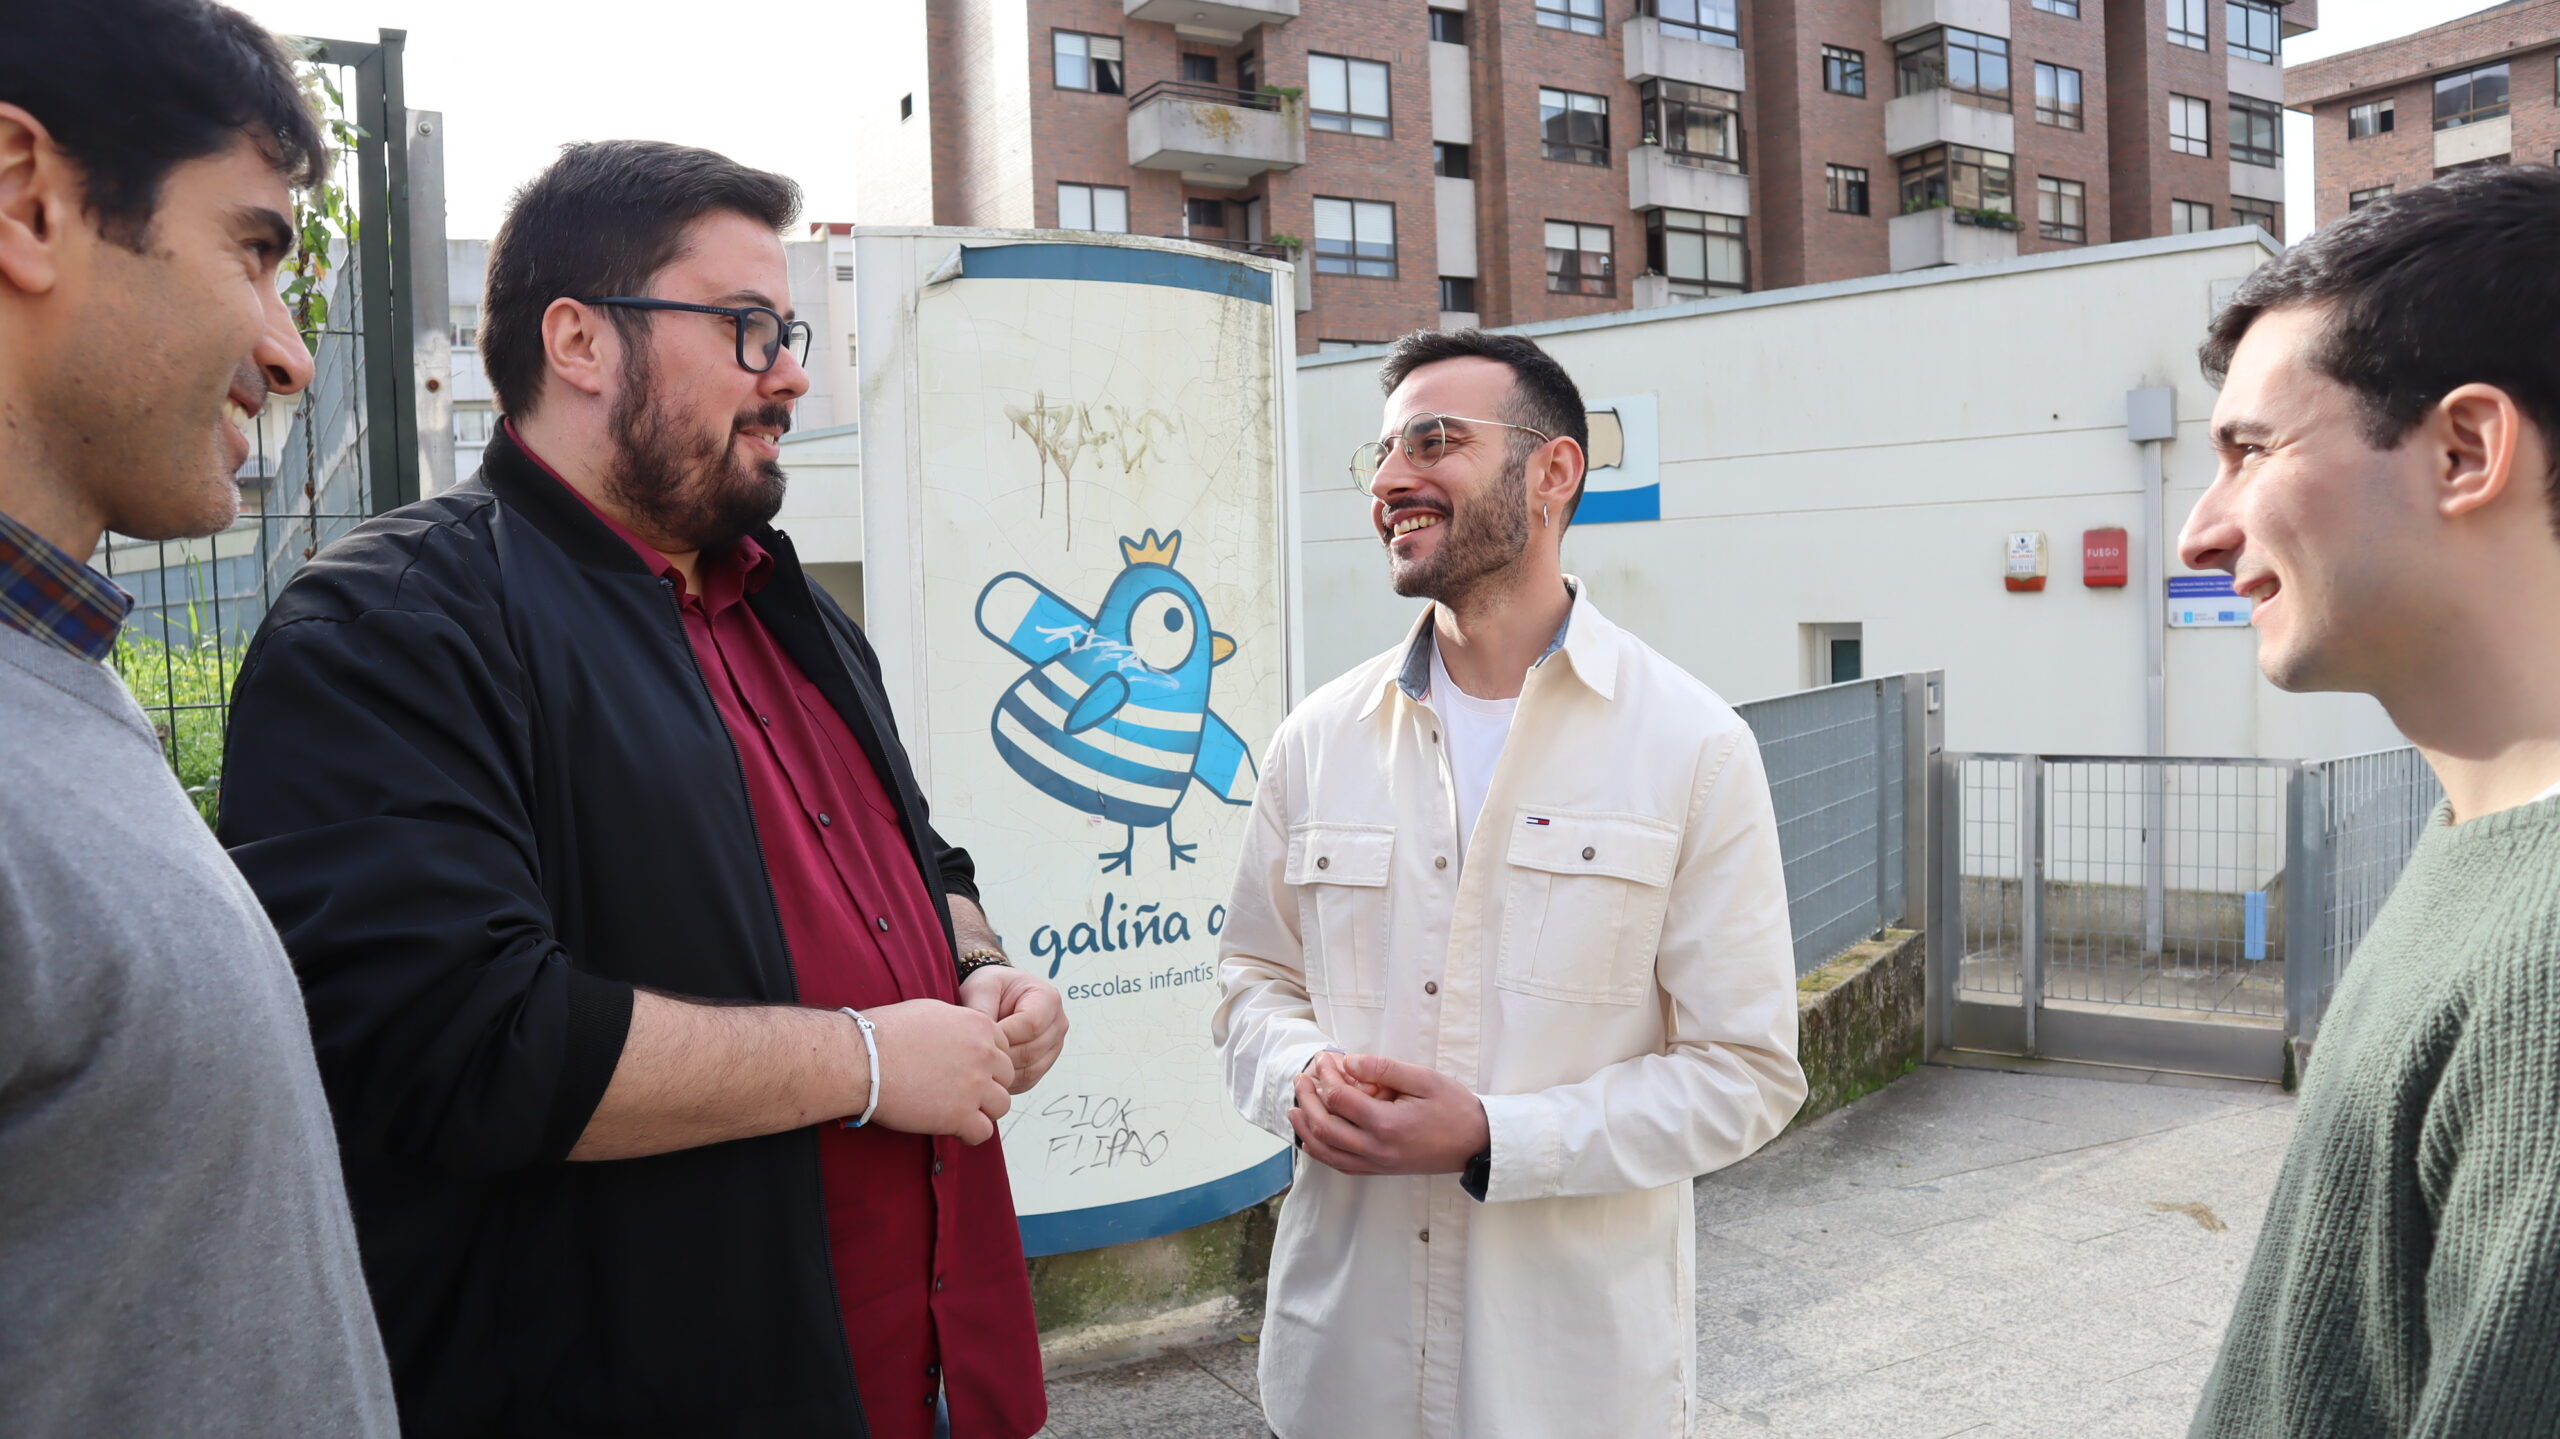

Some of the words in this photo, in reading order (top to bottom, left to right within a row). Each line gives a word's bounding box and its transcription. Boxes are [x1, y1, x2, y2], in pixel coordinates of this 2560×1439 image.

[2087, 547, 2119, 558] FUEGO
[1029, 891, 1191, 979] galiña
[1067, 975, 1142, 1000] escolas
[1149, 961, 1214, 990] infantís
